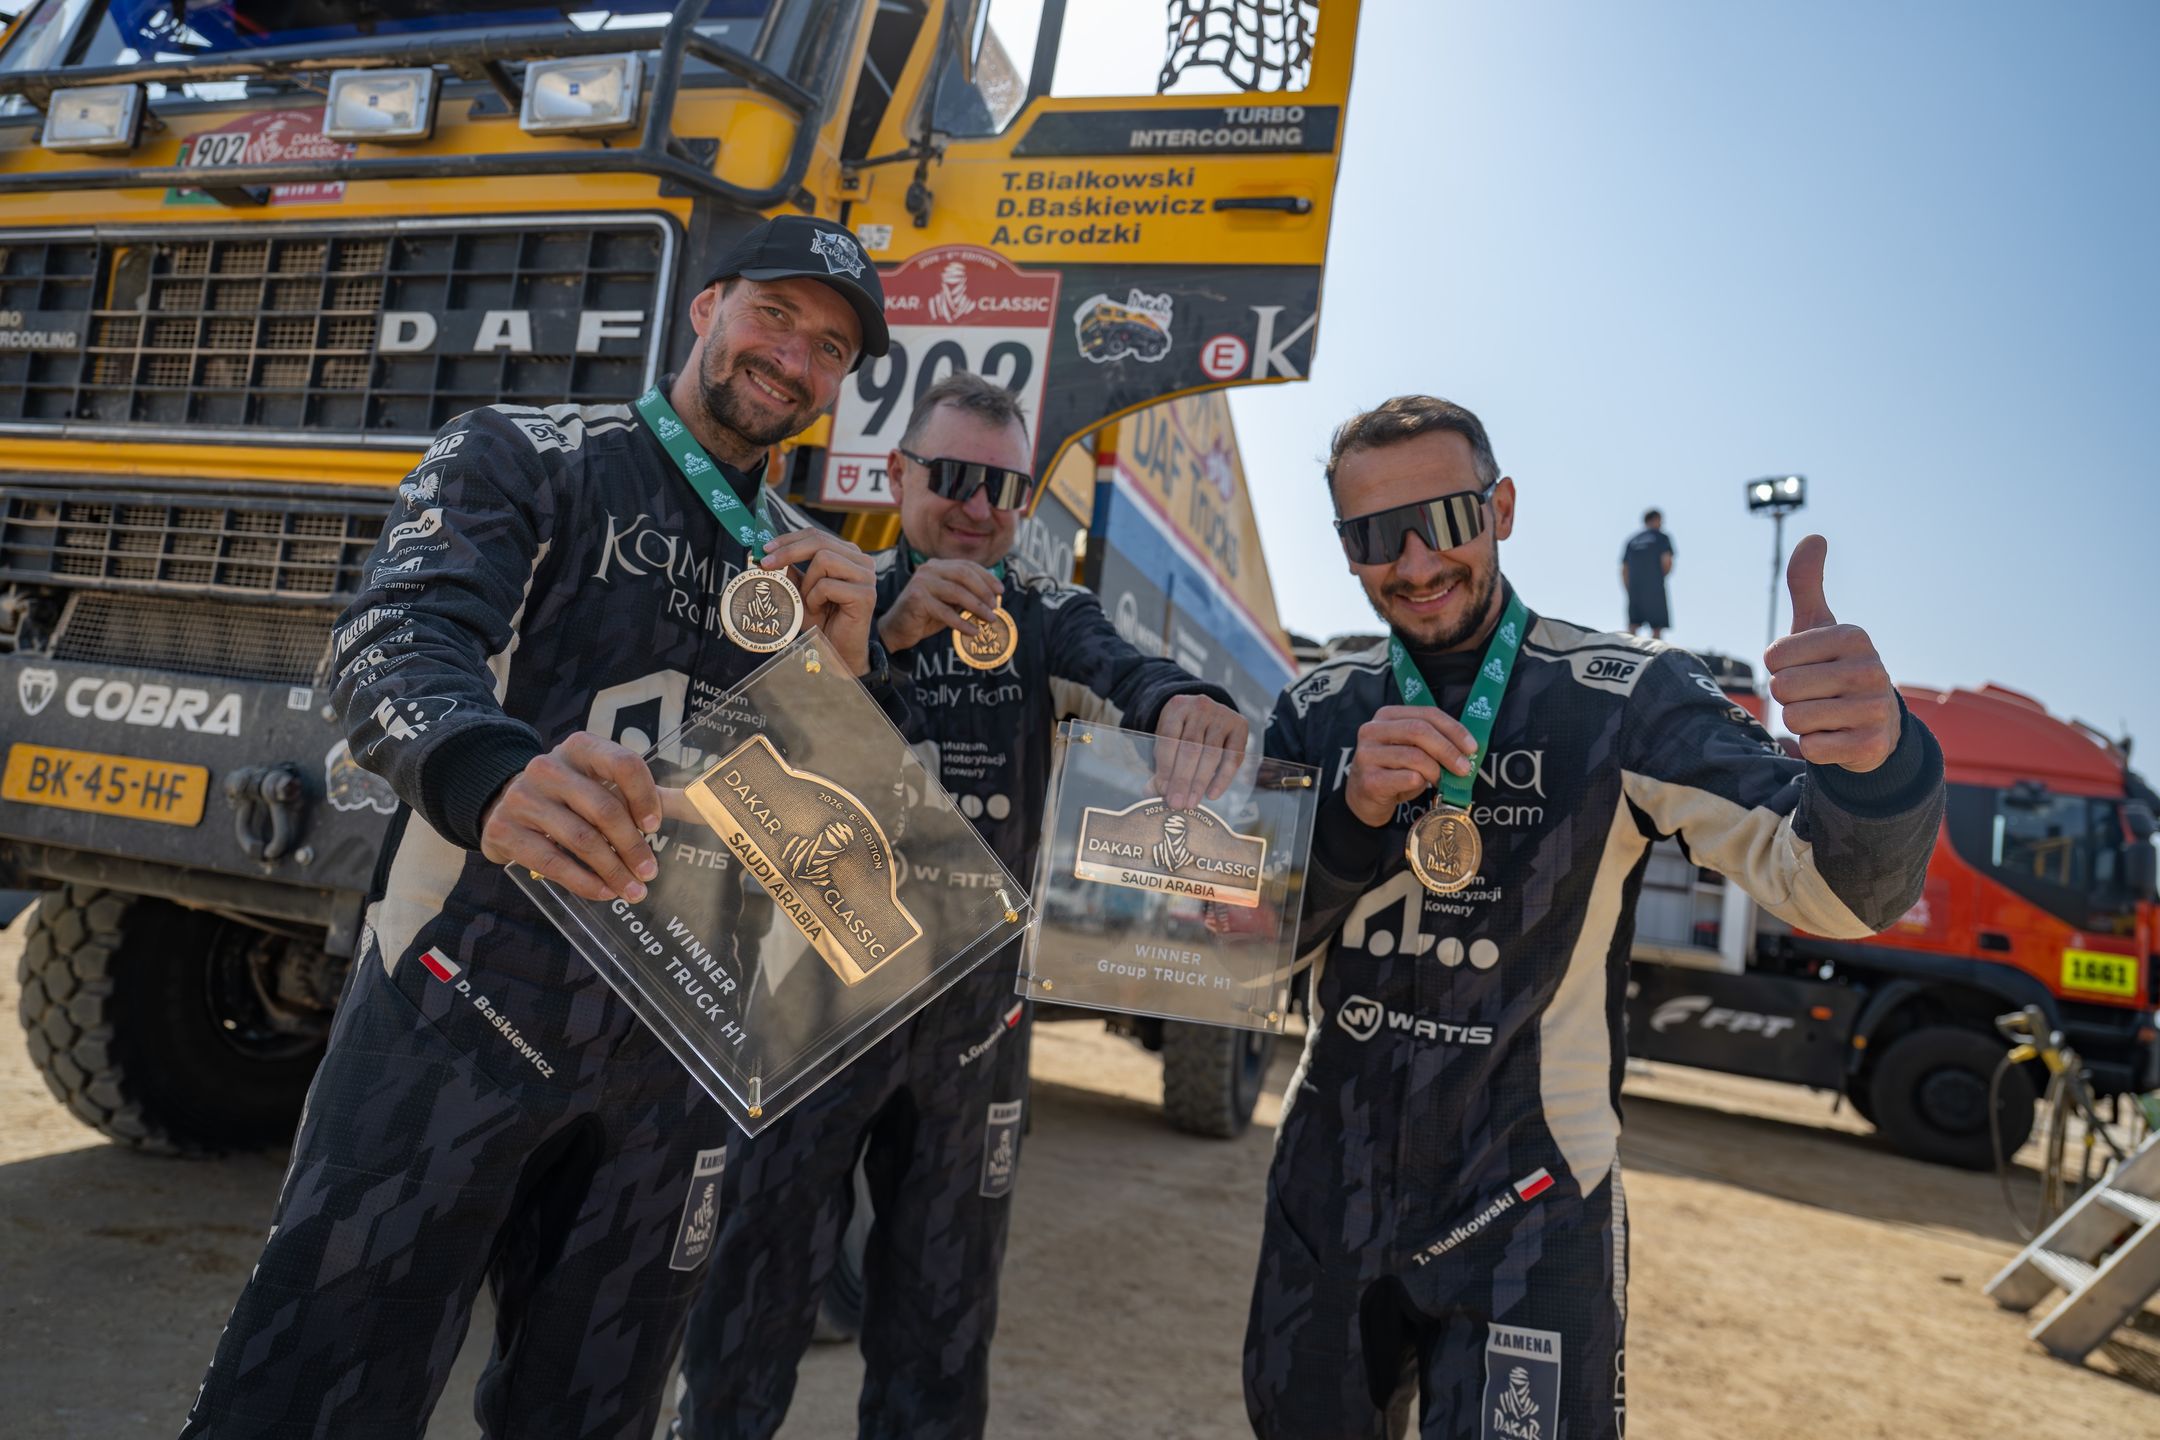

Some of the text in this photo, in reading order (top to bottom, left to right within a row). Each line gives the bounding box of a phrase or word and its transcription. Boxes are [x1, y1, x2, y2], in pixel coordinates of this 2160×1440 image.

[1224, 106, 1304, 124] TURBO
[198, 135, 245, 165] 902
[1130, 127, 1303, 148] INTERCOOLING
[283, 144, 341, 161] CLASSIC
[1002, 167, 1196, 192] T.Białkowski
[995, 193, 1206, 219] D.Baśkiewicz
[990, 222, 1142, 247] A.Grodzki
[885, 295, 1051, 313] KAR CLASSIC
[0, 310, 22, 327] BO
[378, 310, 645, 353] DAF
[0, 331, 77, 349] RCOOLING
[1249, 305, 1317, 380] K
[424, 434, 464, 462] MP
[748, 570, 777, 578] CLASSIC
[779, 576, 801, 604] FINISHER
[742, 614, 781, 636] DAKAR
[1586, 659, 1636, 679] OMP
[65, 677, 242, 737] COBRA
[915, 683, 1023, 708] Rally Team
[27, 756, 187, 812] BK-45-HF
[1472, 802, 1544, 826] eam
[817, 791, 845, 812] 2026
[860, 826, 883, 870] EDITION
[722, 769, 886, 960] DAKAR CLASSIC
[1088, 838, 1257, 879] DAKAR CLASSIC
[1427, 853, 1461, 878] DAKAR
[728, 831, 822, 943] SAUDI ARABIA
[1120, 871, 1215, 898] SAUDI ARABIA
[1425, 901, 1474, 917] Kowary
[666, 915, 737, 996] WINNER
[1135, 943, 1202, 966] WINNER
[611, 898, 748, 1047] Group TRUCK H1
[1097, 959, 1231, 990] Group TRUCK H1
[2072, 958, 2129, 985] 1661
[455, 979, 555, 1079] D. Baśkiewicz
[1388, 1010, 1493, 1045] WATIS
[1700, 1007, 1796, 1039] FPT
[1412, 1251, 1430, 1267] T.
[1494, 1331, 1553, 1355] KAMENA
[1494, 1407, 1540, 1440] DAKAR
